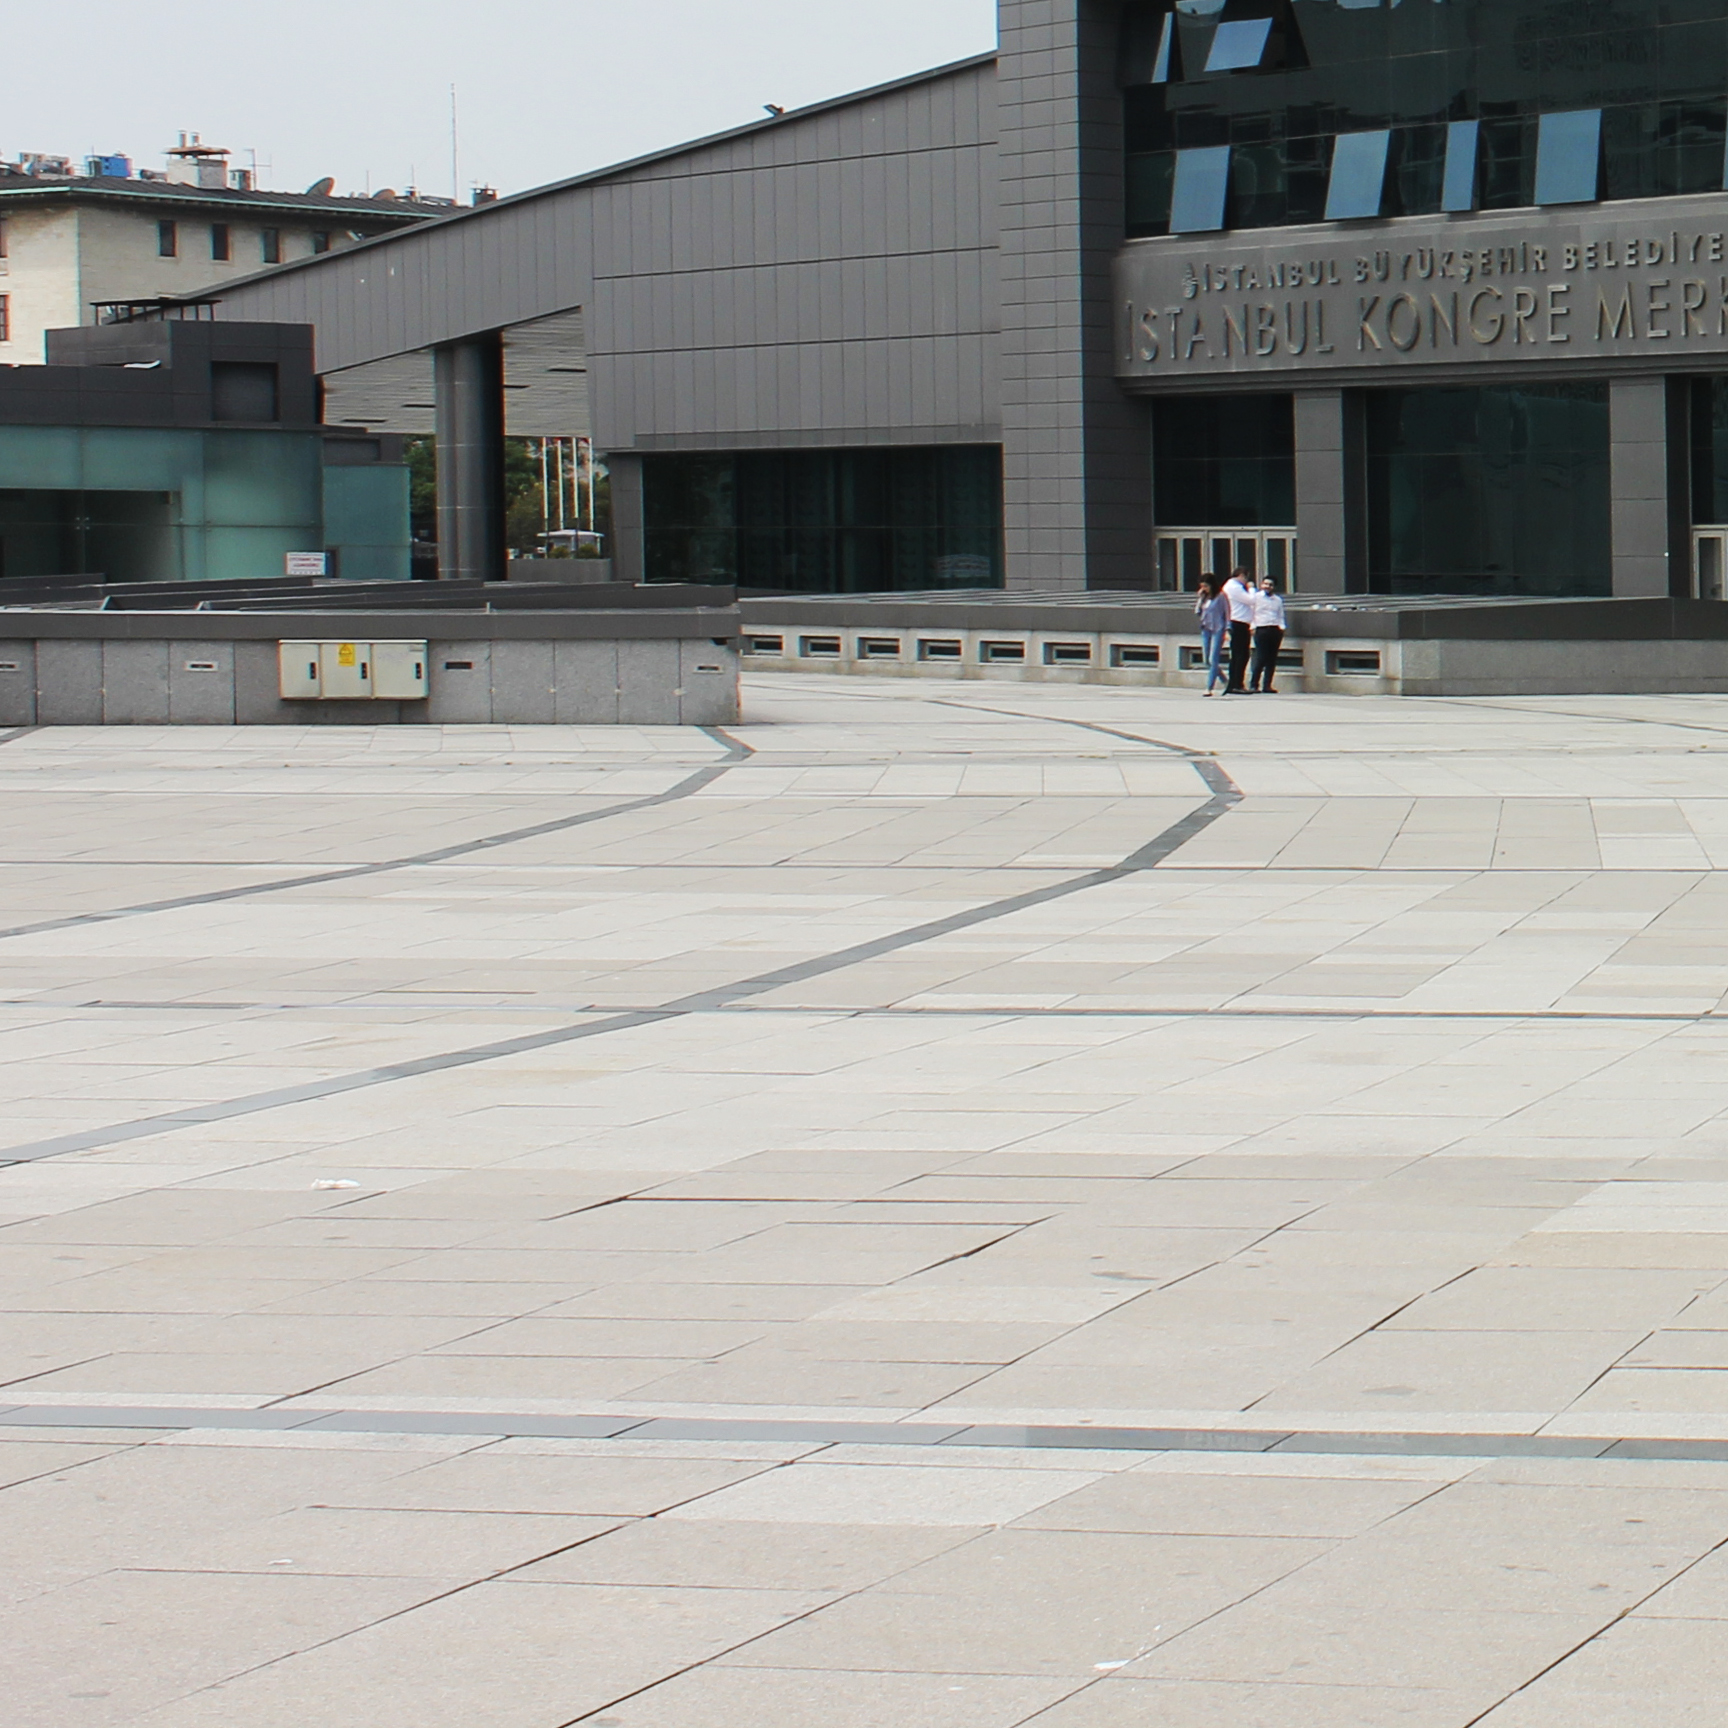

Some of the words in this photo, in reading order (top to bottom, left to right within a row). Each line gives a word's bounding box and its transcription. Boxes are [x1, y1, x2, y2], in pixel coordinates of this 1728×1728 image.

[1203, 258, 1341, 293] İSTANBUL
[1354, 239, 1547, 284] BÜYÜKŞEHİR
[1122, 298, 1335, 363] İSTANBUL
[1357, 283, 1571, 352] KONGRE
